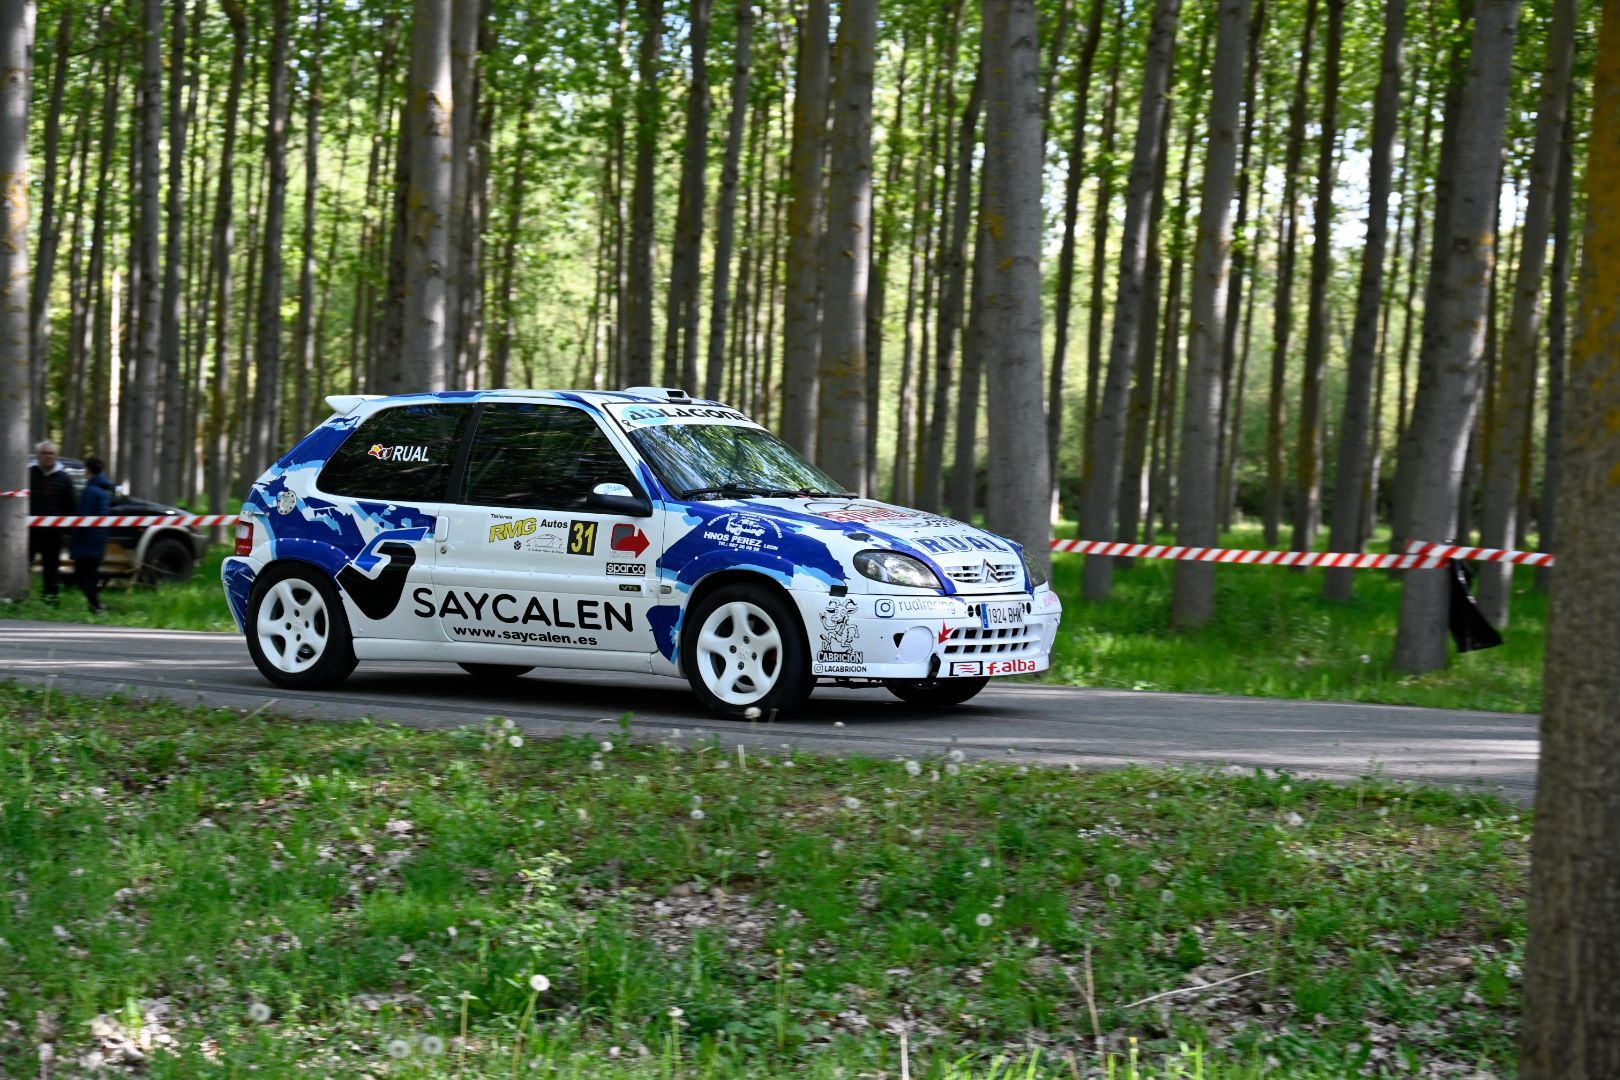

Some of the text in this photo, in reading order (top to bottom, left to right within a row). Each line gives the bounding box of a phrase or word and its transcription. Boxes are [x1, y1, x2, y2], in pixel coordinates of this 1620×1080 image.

[392, 445, 429, 462] RUAL
[489, 517, 537, 543] RMG
[540, 518, 568, 529] Autos
[571, 522, 595, 554] 31
[703, 531, 730, 542] HNOS
[730, 535, 763, 547] PEREZ
[914, 535, 1009, 554] RUAL
[607, 563, 645, 576] sparco
[413, 588, 633, 632] SAYCALEN
[988, 607, 1007, 624] 1924
[453, 626, 598, 646] www.saycalen.es
[986, 658, 1037, 675] f.alba
